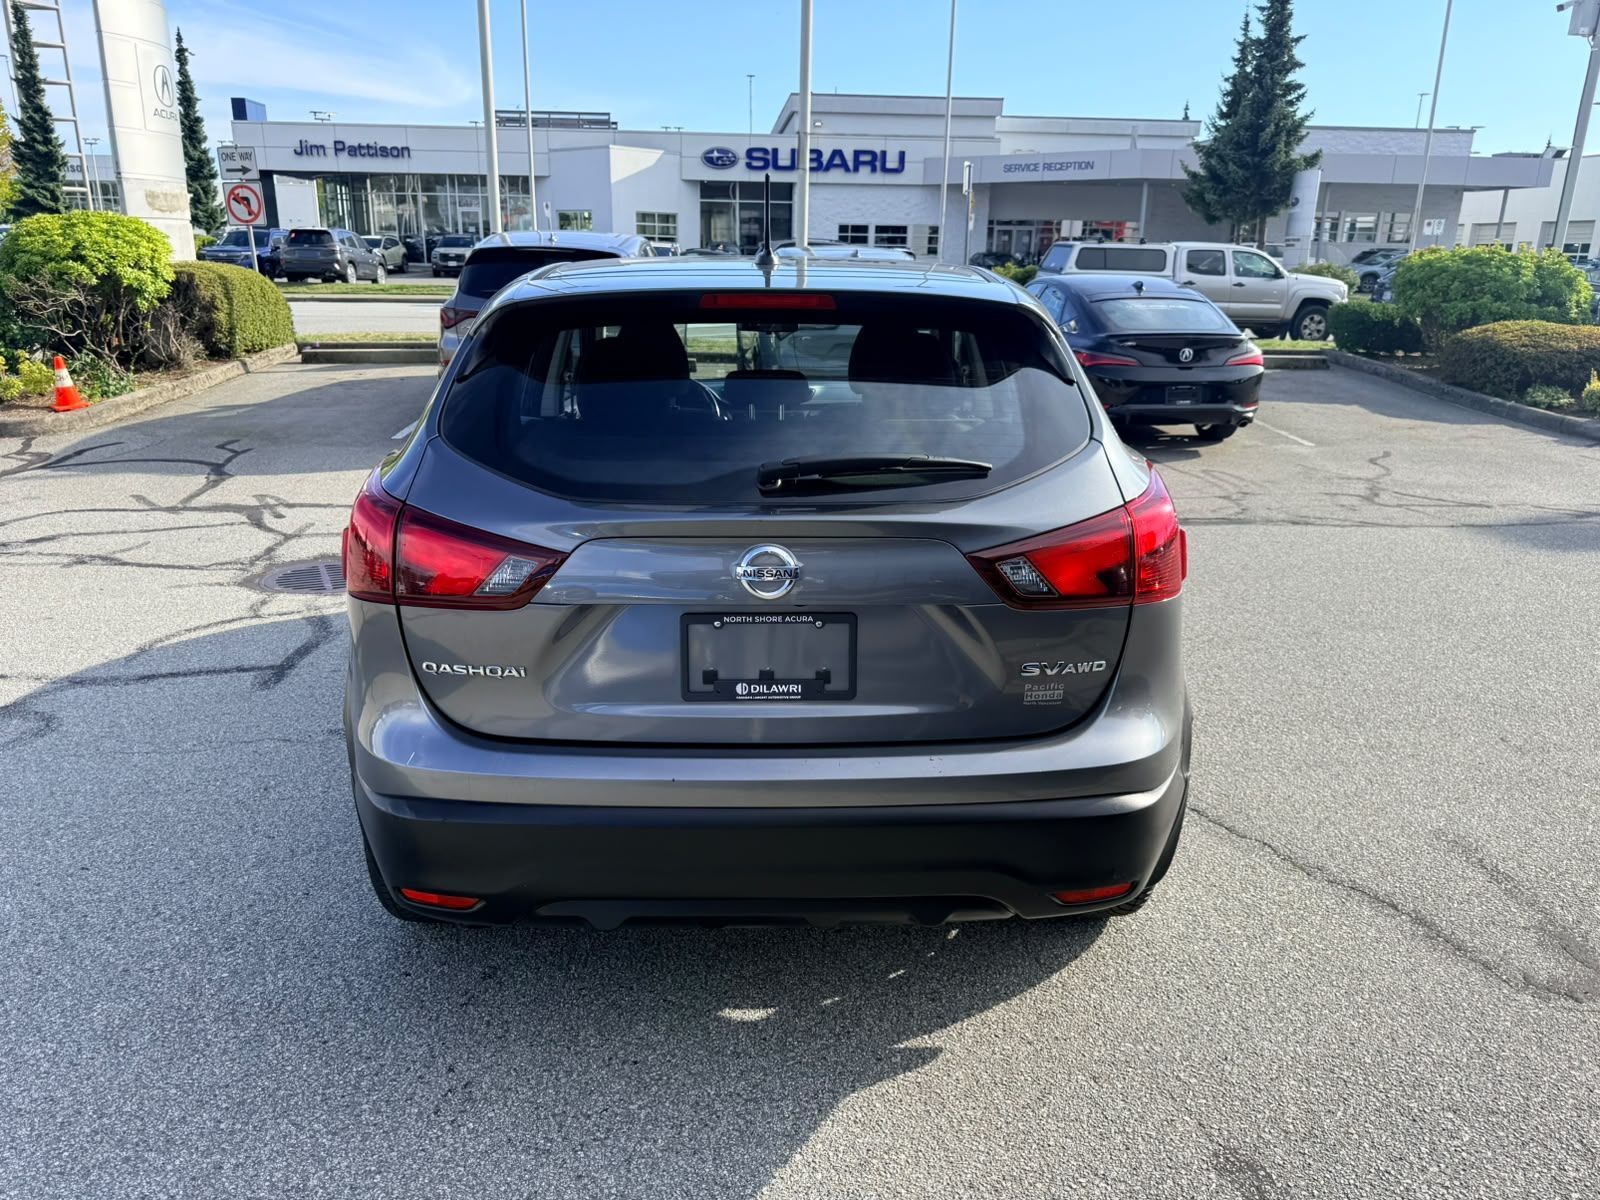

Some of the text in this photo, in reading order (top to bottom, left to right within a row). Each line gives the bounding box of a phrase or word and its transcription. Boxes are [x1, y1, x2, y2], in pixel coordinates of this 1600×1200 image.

[294, 140, 411, 158] Jim Pattison
[221, 151, 253, 162] ONE WAY
[745, 147, 906, 174] SUBARU
[1003, 161, 1095, 173] SERVICE RECEPTION
[742, 568, 793, 579] NISSAN
[750, 684, 802, 693] DILAWRI
[1024, 683, 1064, 691] Pacific
[1025, 691, 1062, 700] Honda
